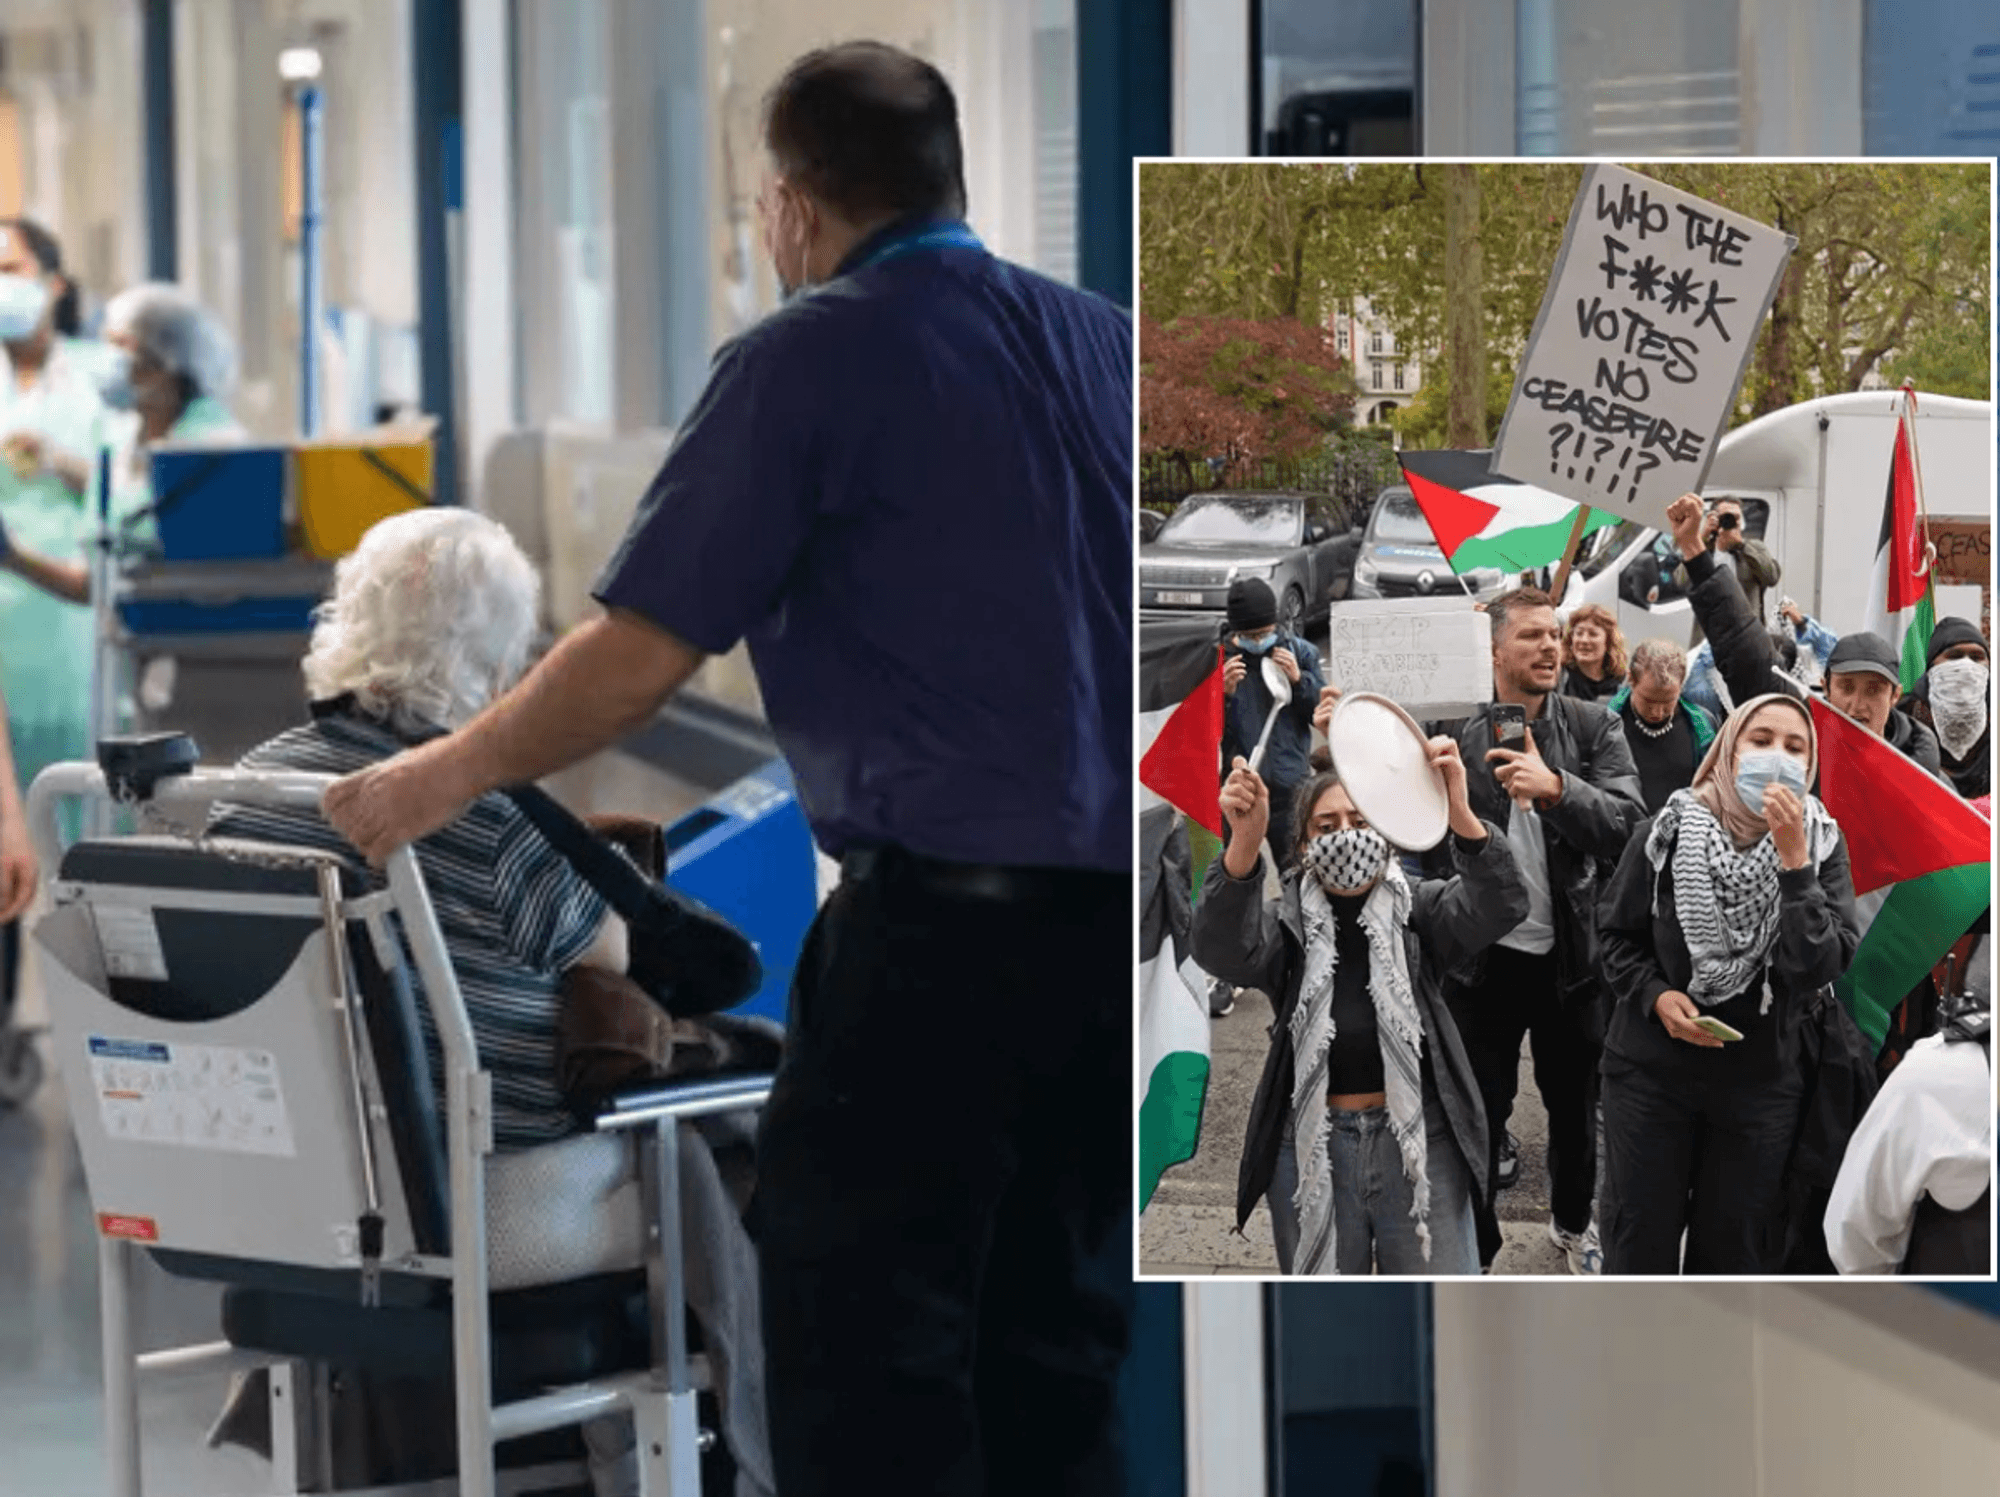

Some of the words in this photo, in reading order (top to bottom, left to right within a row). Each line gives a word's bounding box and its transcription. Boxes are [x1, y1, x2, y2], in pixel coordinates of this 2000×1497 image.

[1597, 183, 1668, 239] WHO
[1676, 204, 1751, 266] THE
[1577, 297, 1699, 384] VOTES
[1596, 357, 1649, 402] NO
[1522, 377, 1705, 463] CEASEFIRE
[1336, 616, 1431, 654] STOP
